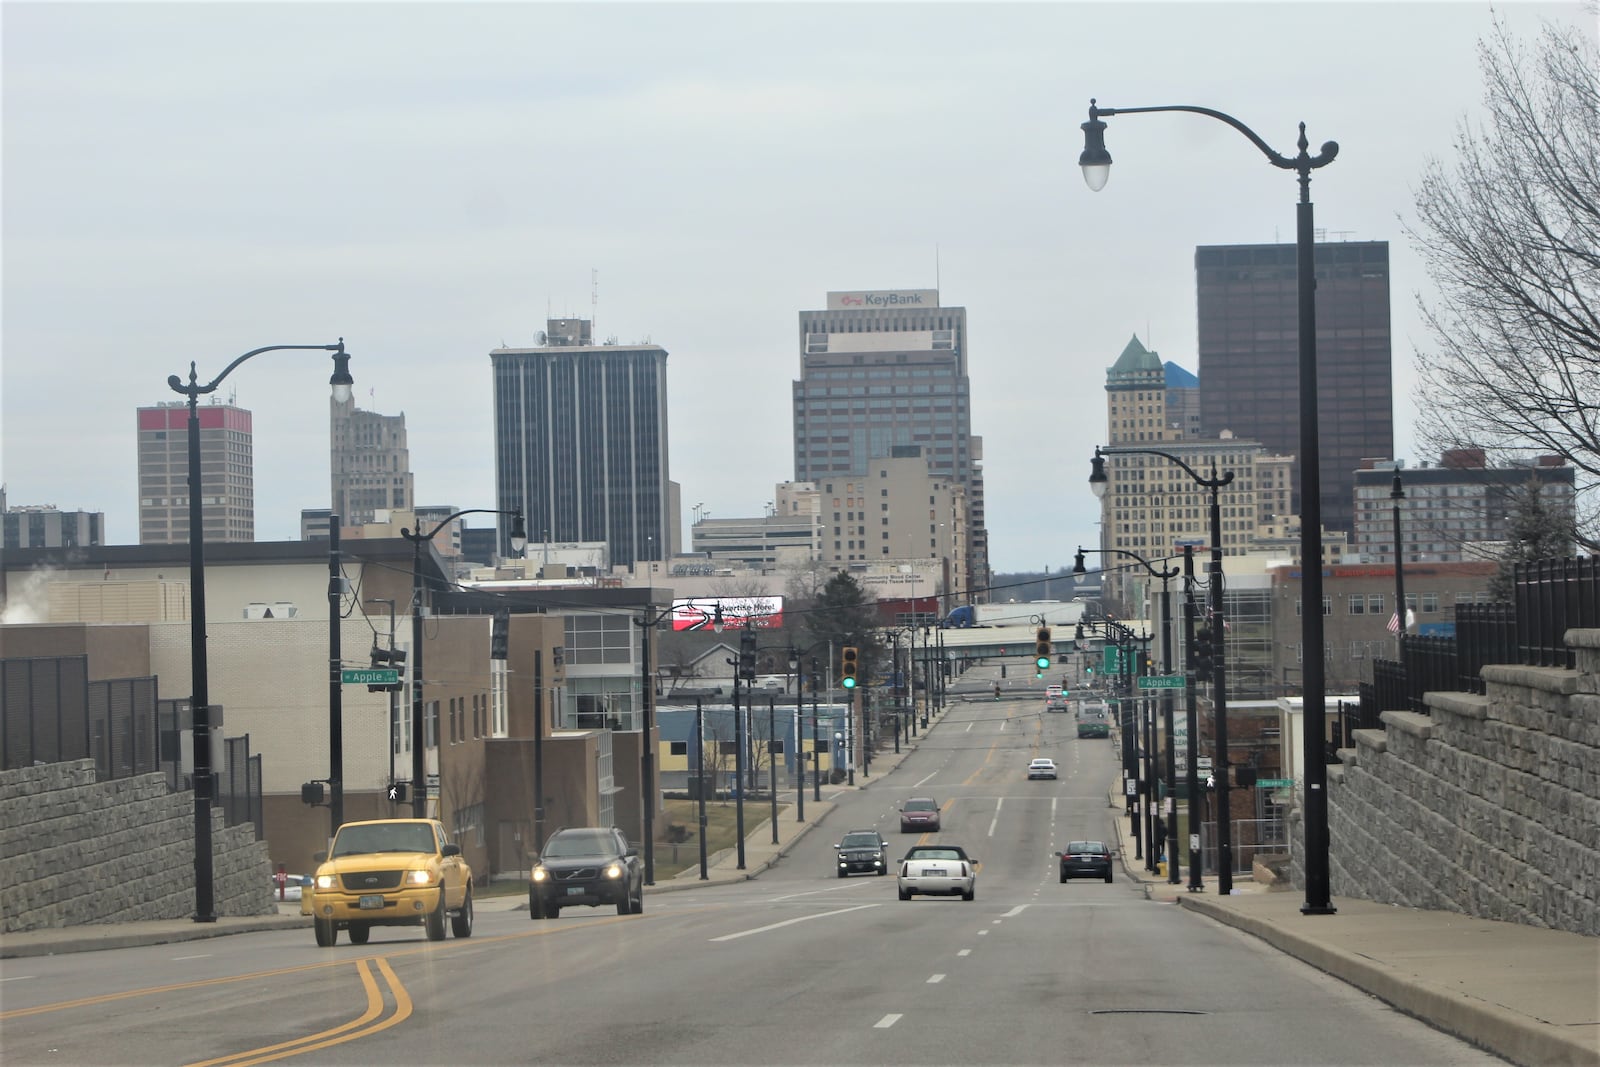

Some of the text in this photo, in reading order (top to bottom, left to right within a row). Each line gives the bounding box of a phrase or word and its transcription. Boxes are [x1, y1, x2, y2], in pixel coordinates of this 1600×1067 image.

[865, 293, 922, 307] KeyBank
[352, 672, 382, 683] Apple
[1146, 678, 1172, 687] Apple
